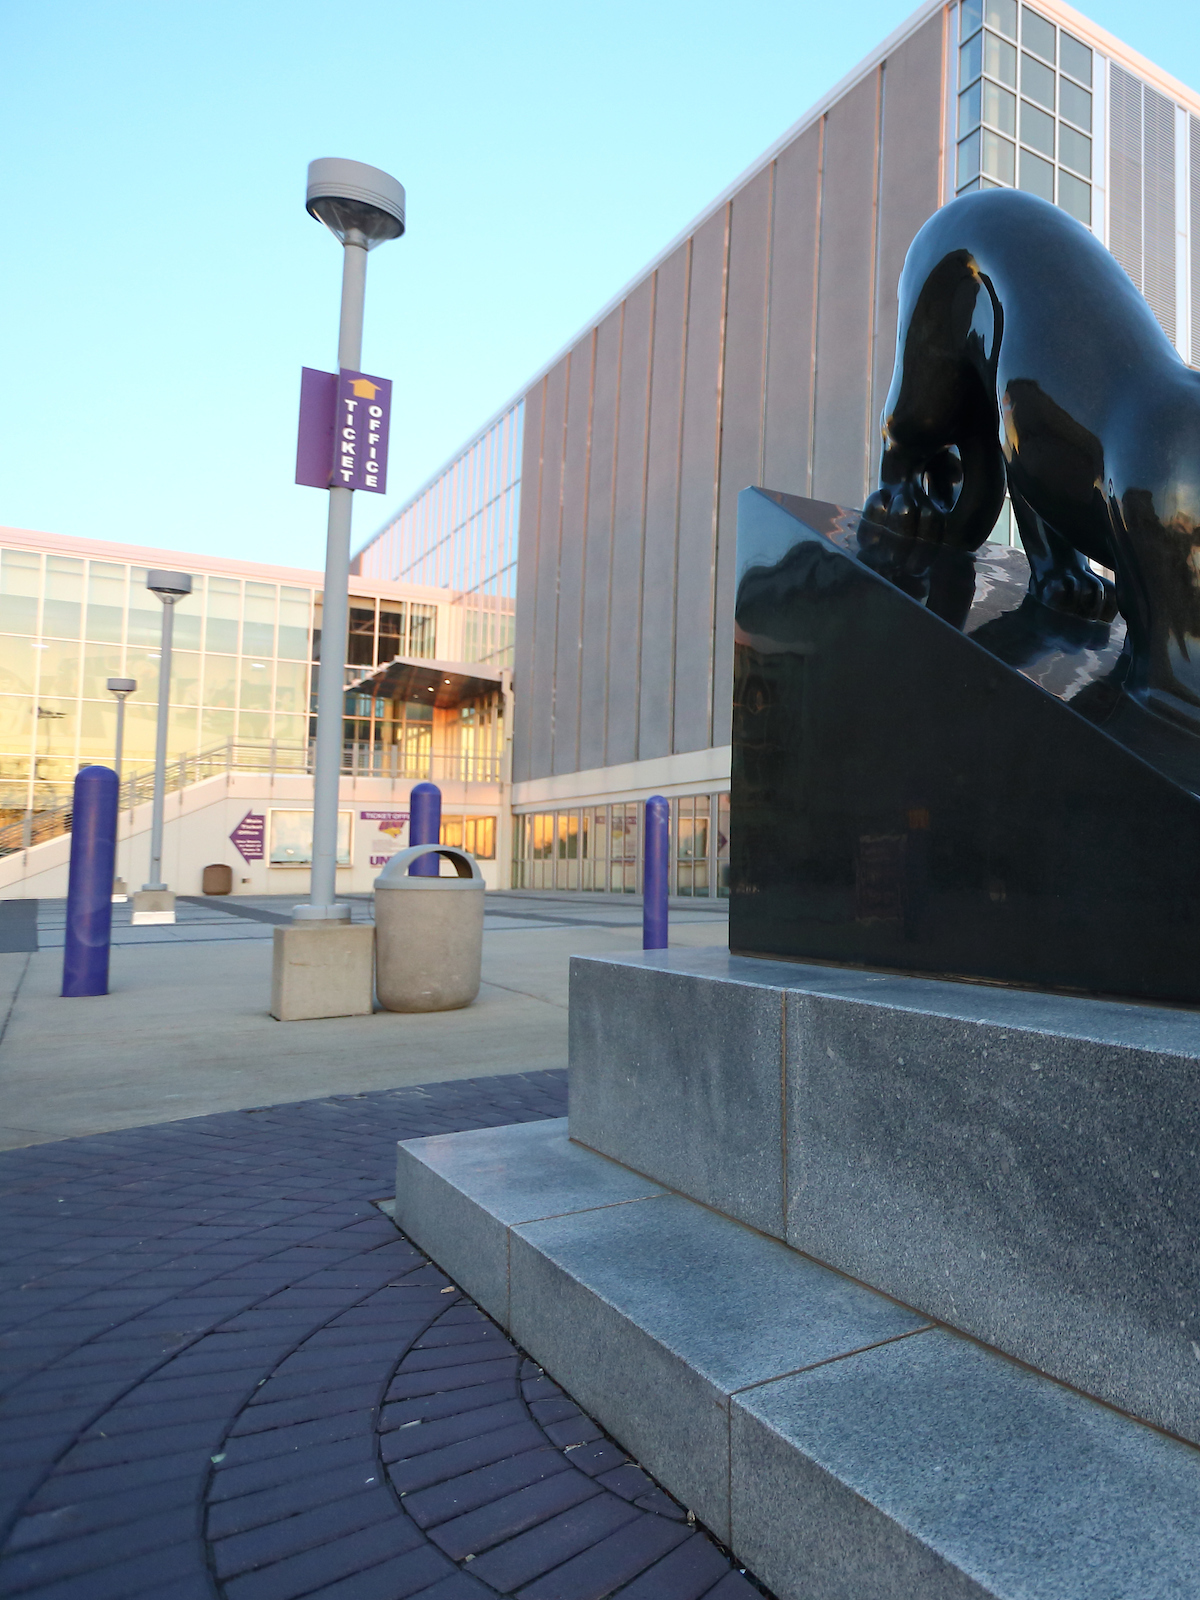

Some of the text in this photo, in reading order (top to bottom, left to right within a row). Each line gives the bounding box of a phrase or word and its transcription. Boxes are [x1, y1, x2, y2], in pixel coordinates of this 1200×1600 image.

[341, 400, 358, 482] TICKET
[365, 406, 383, 487] OFFICE
[370, 856, 391, 865] UN
